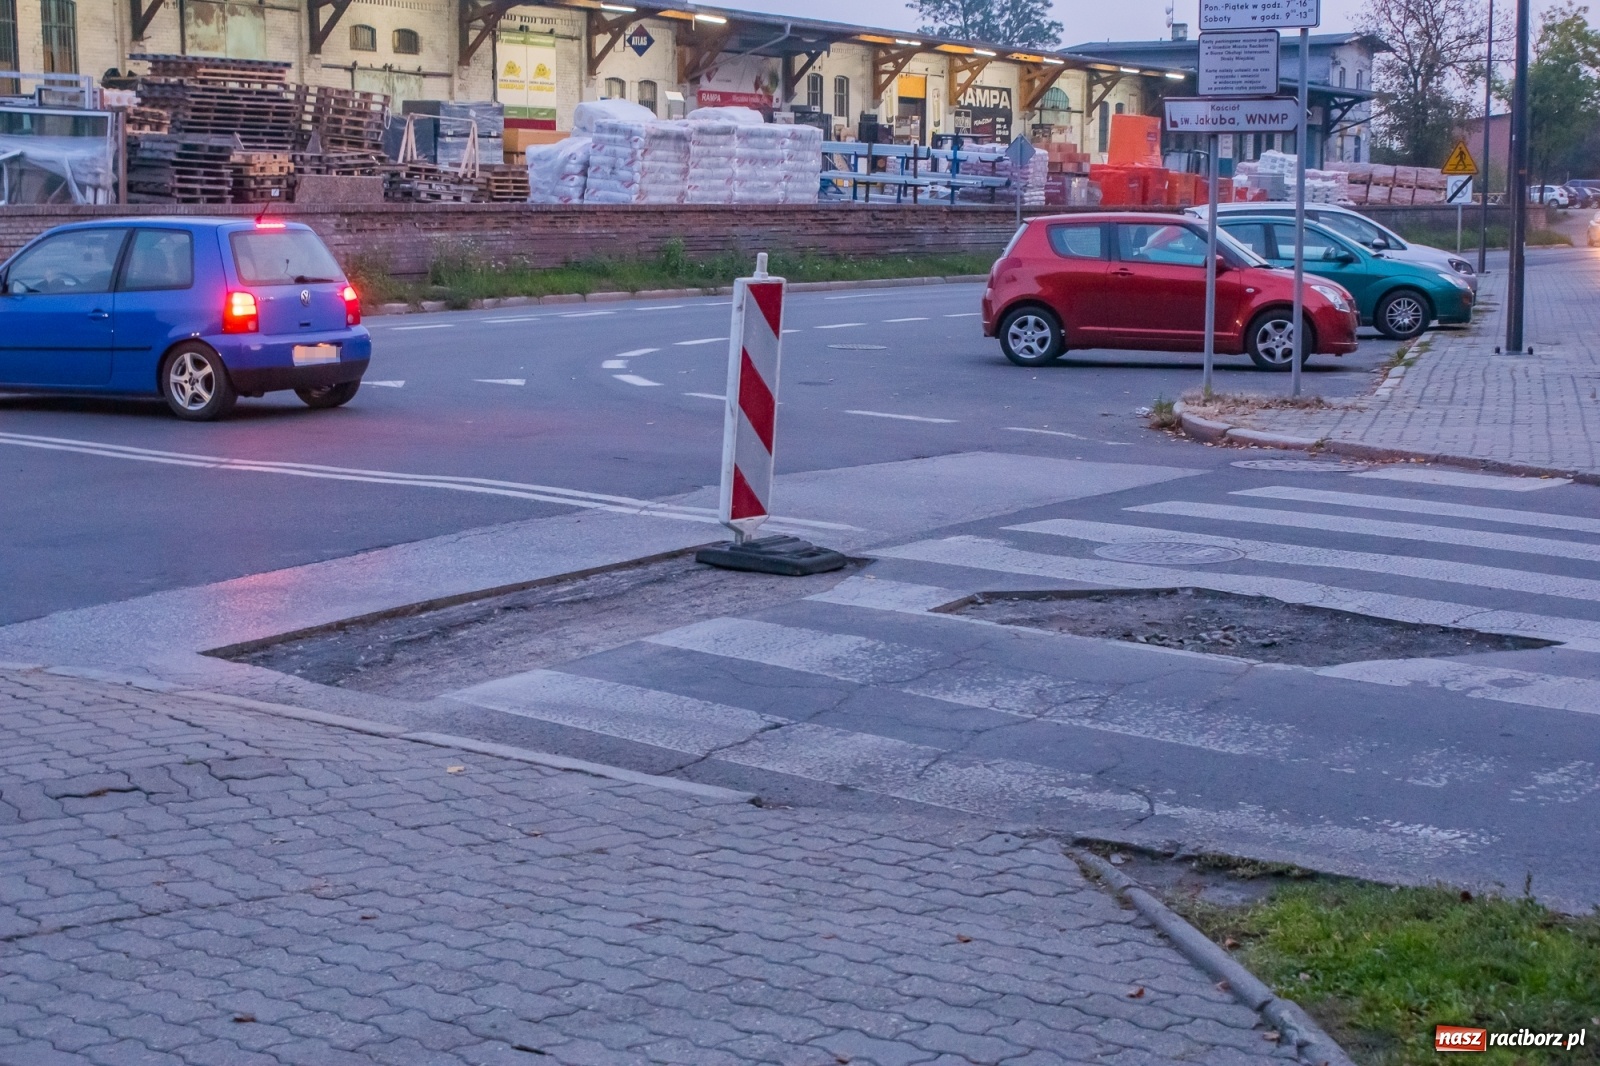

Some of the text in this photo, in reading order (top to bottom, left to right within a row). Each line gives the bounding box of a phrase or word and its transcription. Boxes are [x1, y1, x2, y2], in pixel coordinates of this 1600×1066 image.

[1261, 2, 1283, 11] godz.
[1260, 13, 1282, 22] godz.
[632, 36, 647, 46] ATLAS
[702, 92, 721, 102] RAMPA
[1180, 113, 1288, 126] św. Jakuba, WNMP
